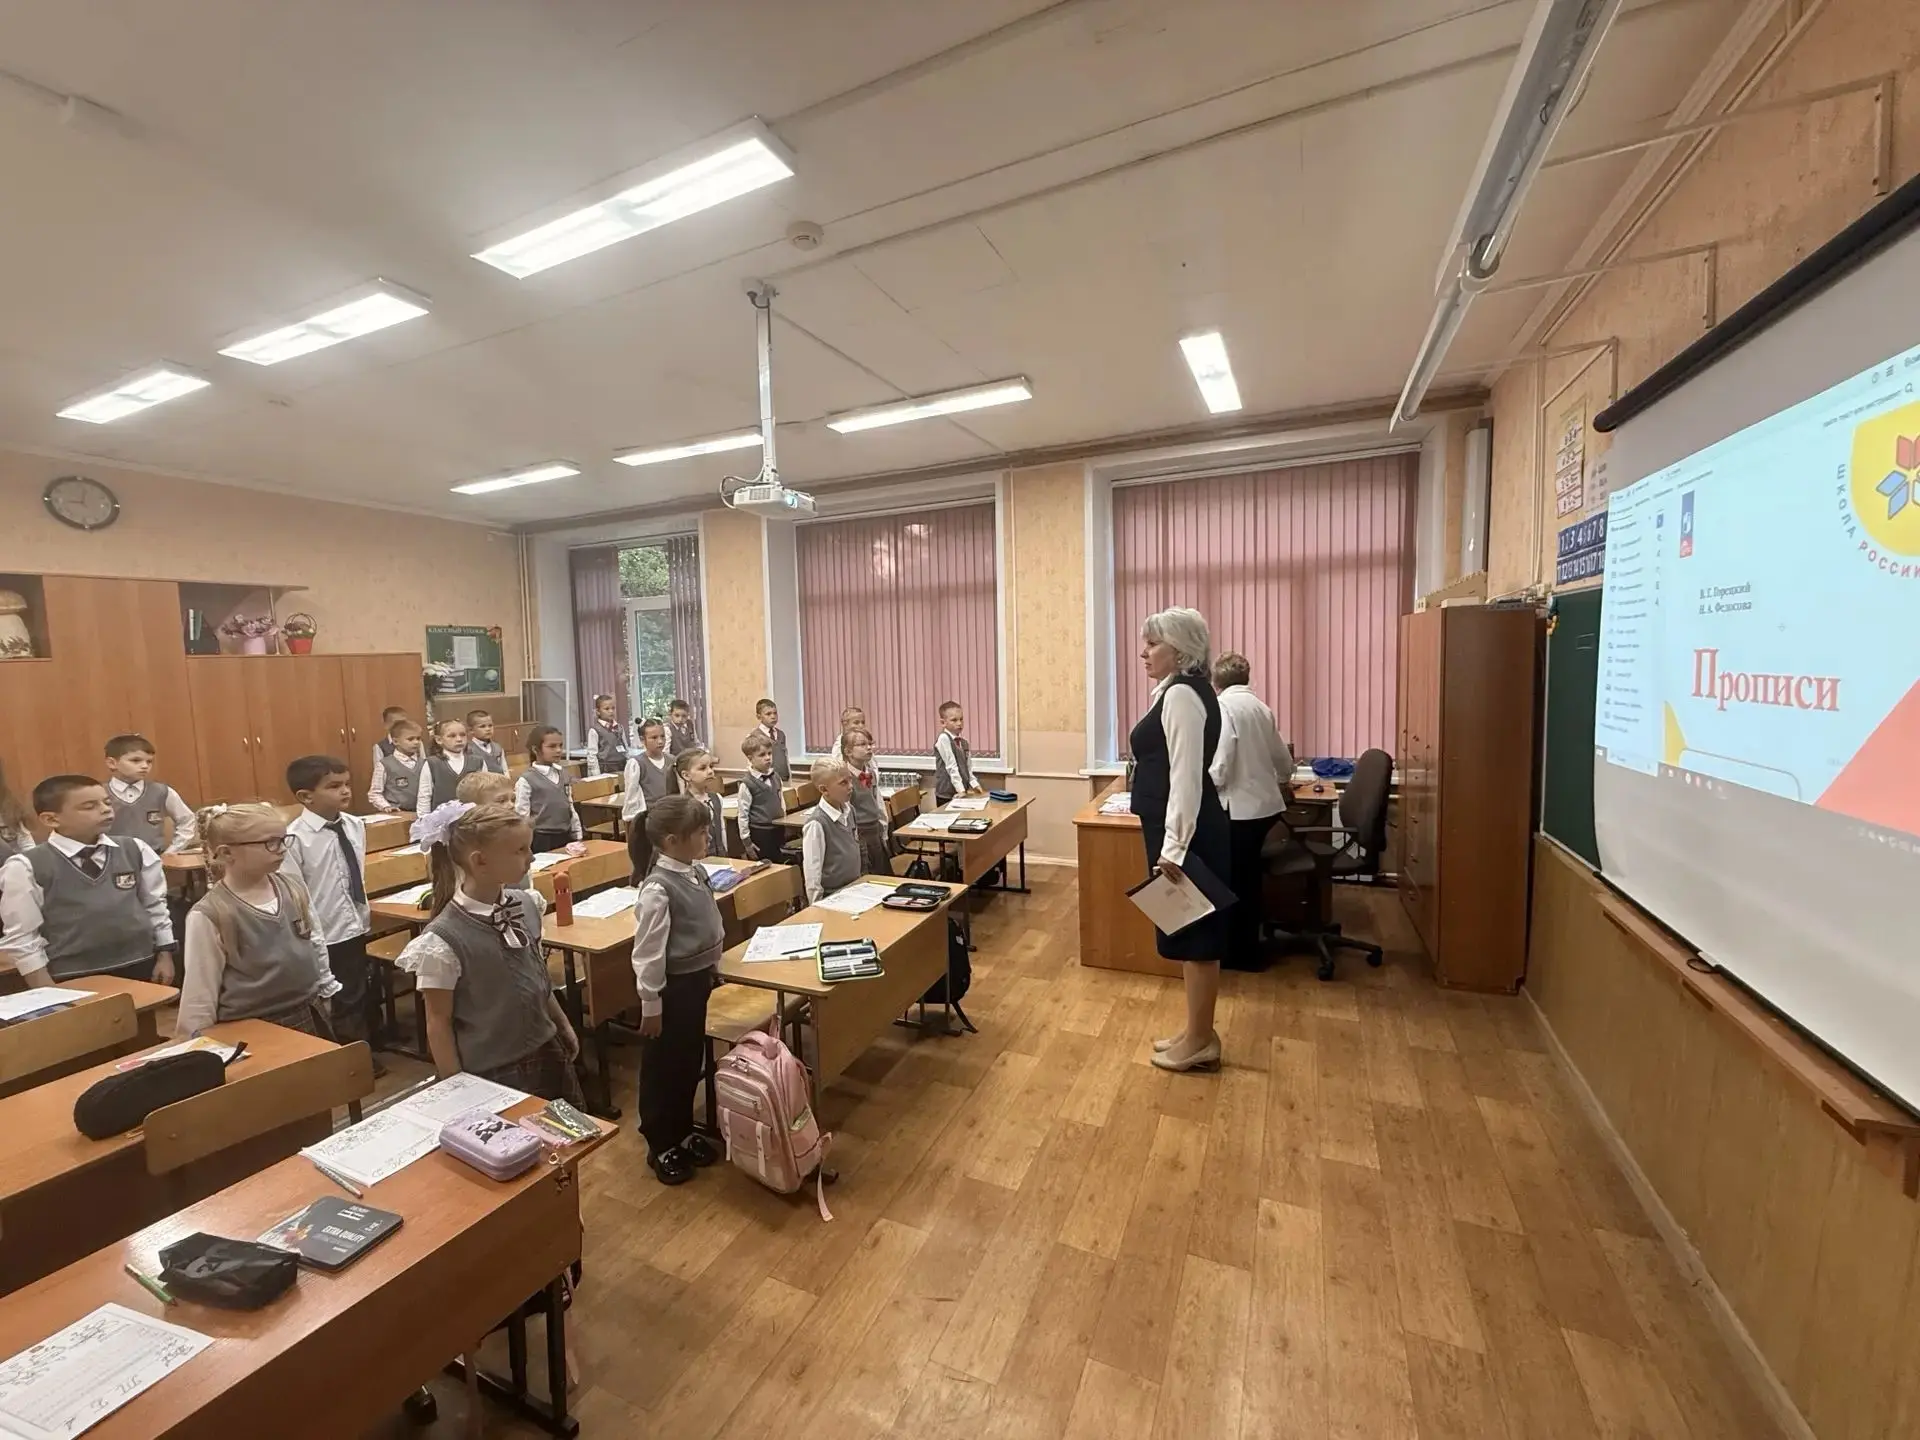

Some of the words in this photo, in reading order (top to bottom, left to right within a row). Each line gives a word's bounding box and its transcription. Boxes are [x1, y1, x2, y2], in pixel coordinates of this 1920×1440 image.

[1599, 518, 1604, 538] 8
[1836, 463, 1857, 539] ШКОЛА
[1858, 540, 1920, 578] РОССИИ
[1691, 648, 1841, 711] Прописи
[321, 1225, 342, 1236] EXTRA
[340, 1228, 366, 1243] QUALITY
